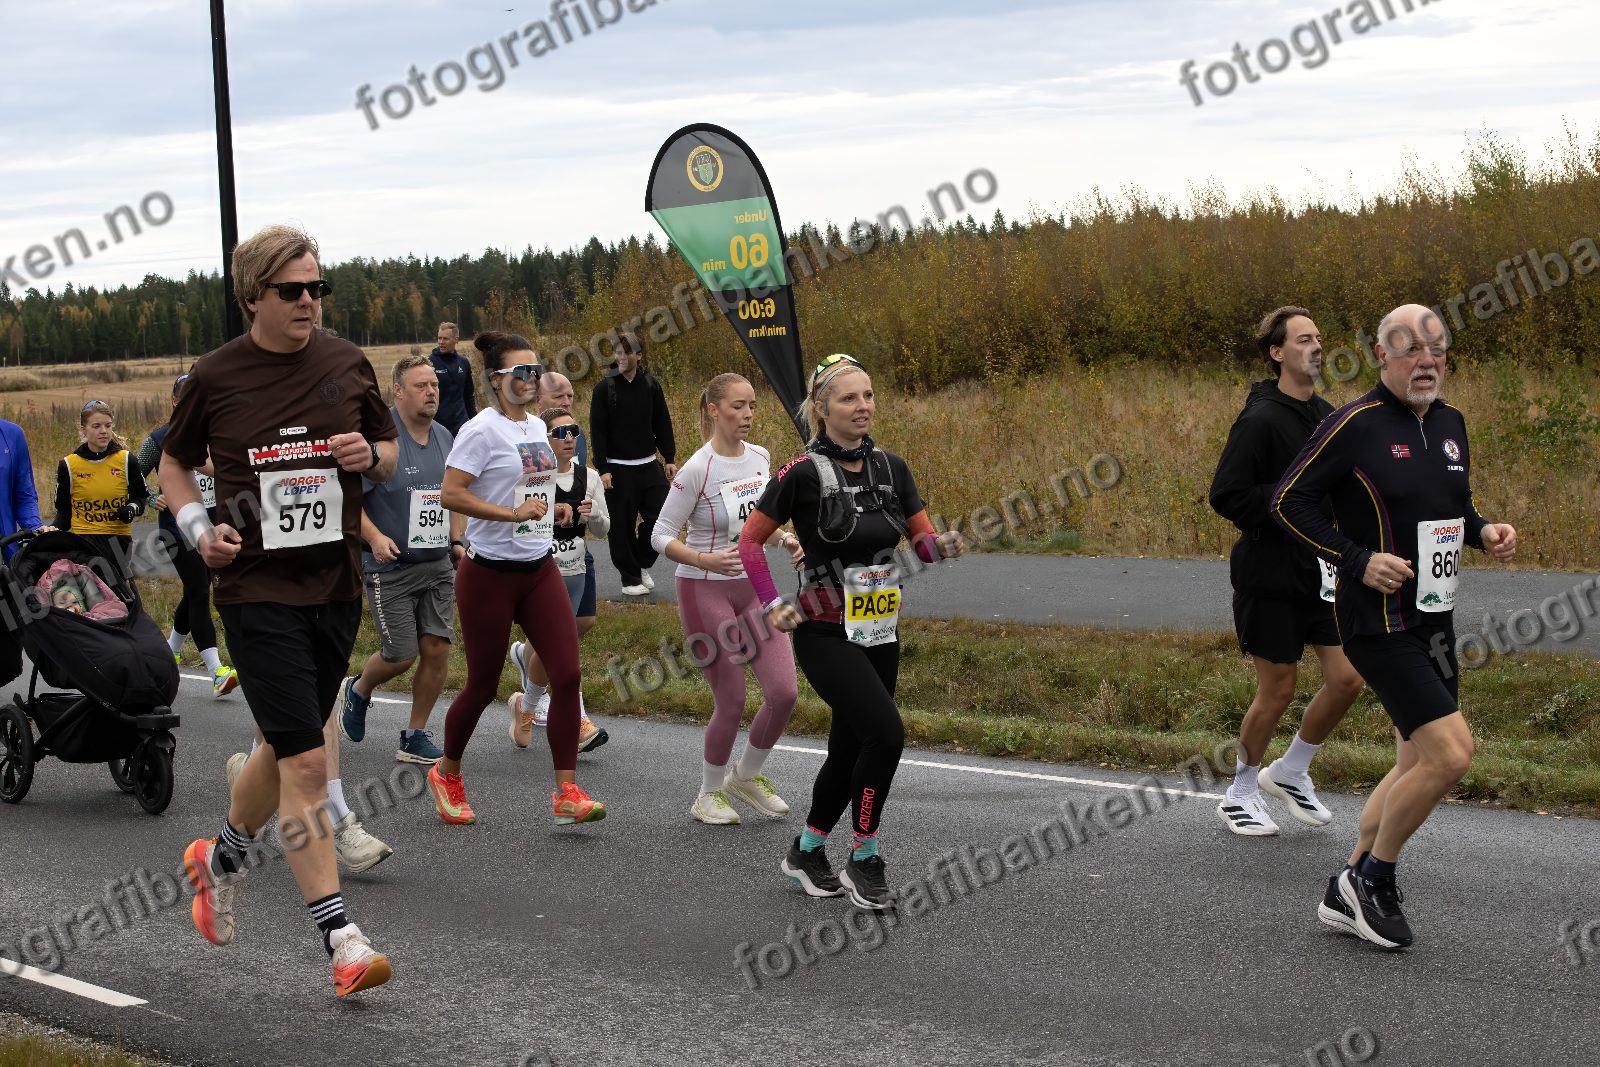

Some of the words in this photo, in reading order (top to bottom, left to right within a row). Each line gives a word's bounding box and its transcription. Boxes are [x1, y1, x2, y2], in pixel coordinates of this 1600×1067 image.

[280, 476, 326, 487] NORGES
[731, 480, 762, 492] NORGES
[283, 485, 320, 496] LØPET
[737, 487, 760, 498] LØPET
[279, 500, 327, 533] 579
[418, 509, 444, 527] 594
[1432, 549, 1459, 579] 860
[858, 569, 891, 580] NORGES
[864, 577, 887, 587] LØPET
[852, 592, 897, 617] PACE
[859, 787, 875, 832] ADIZERO
